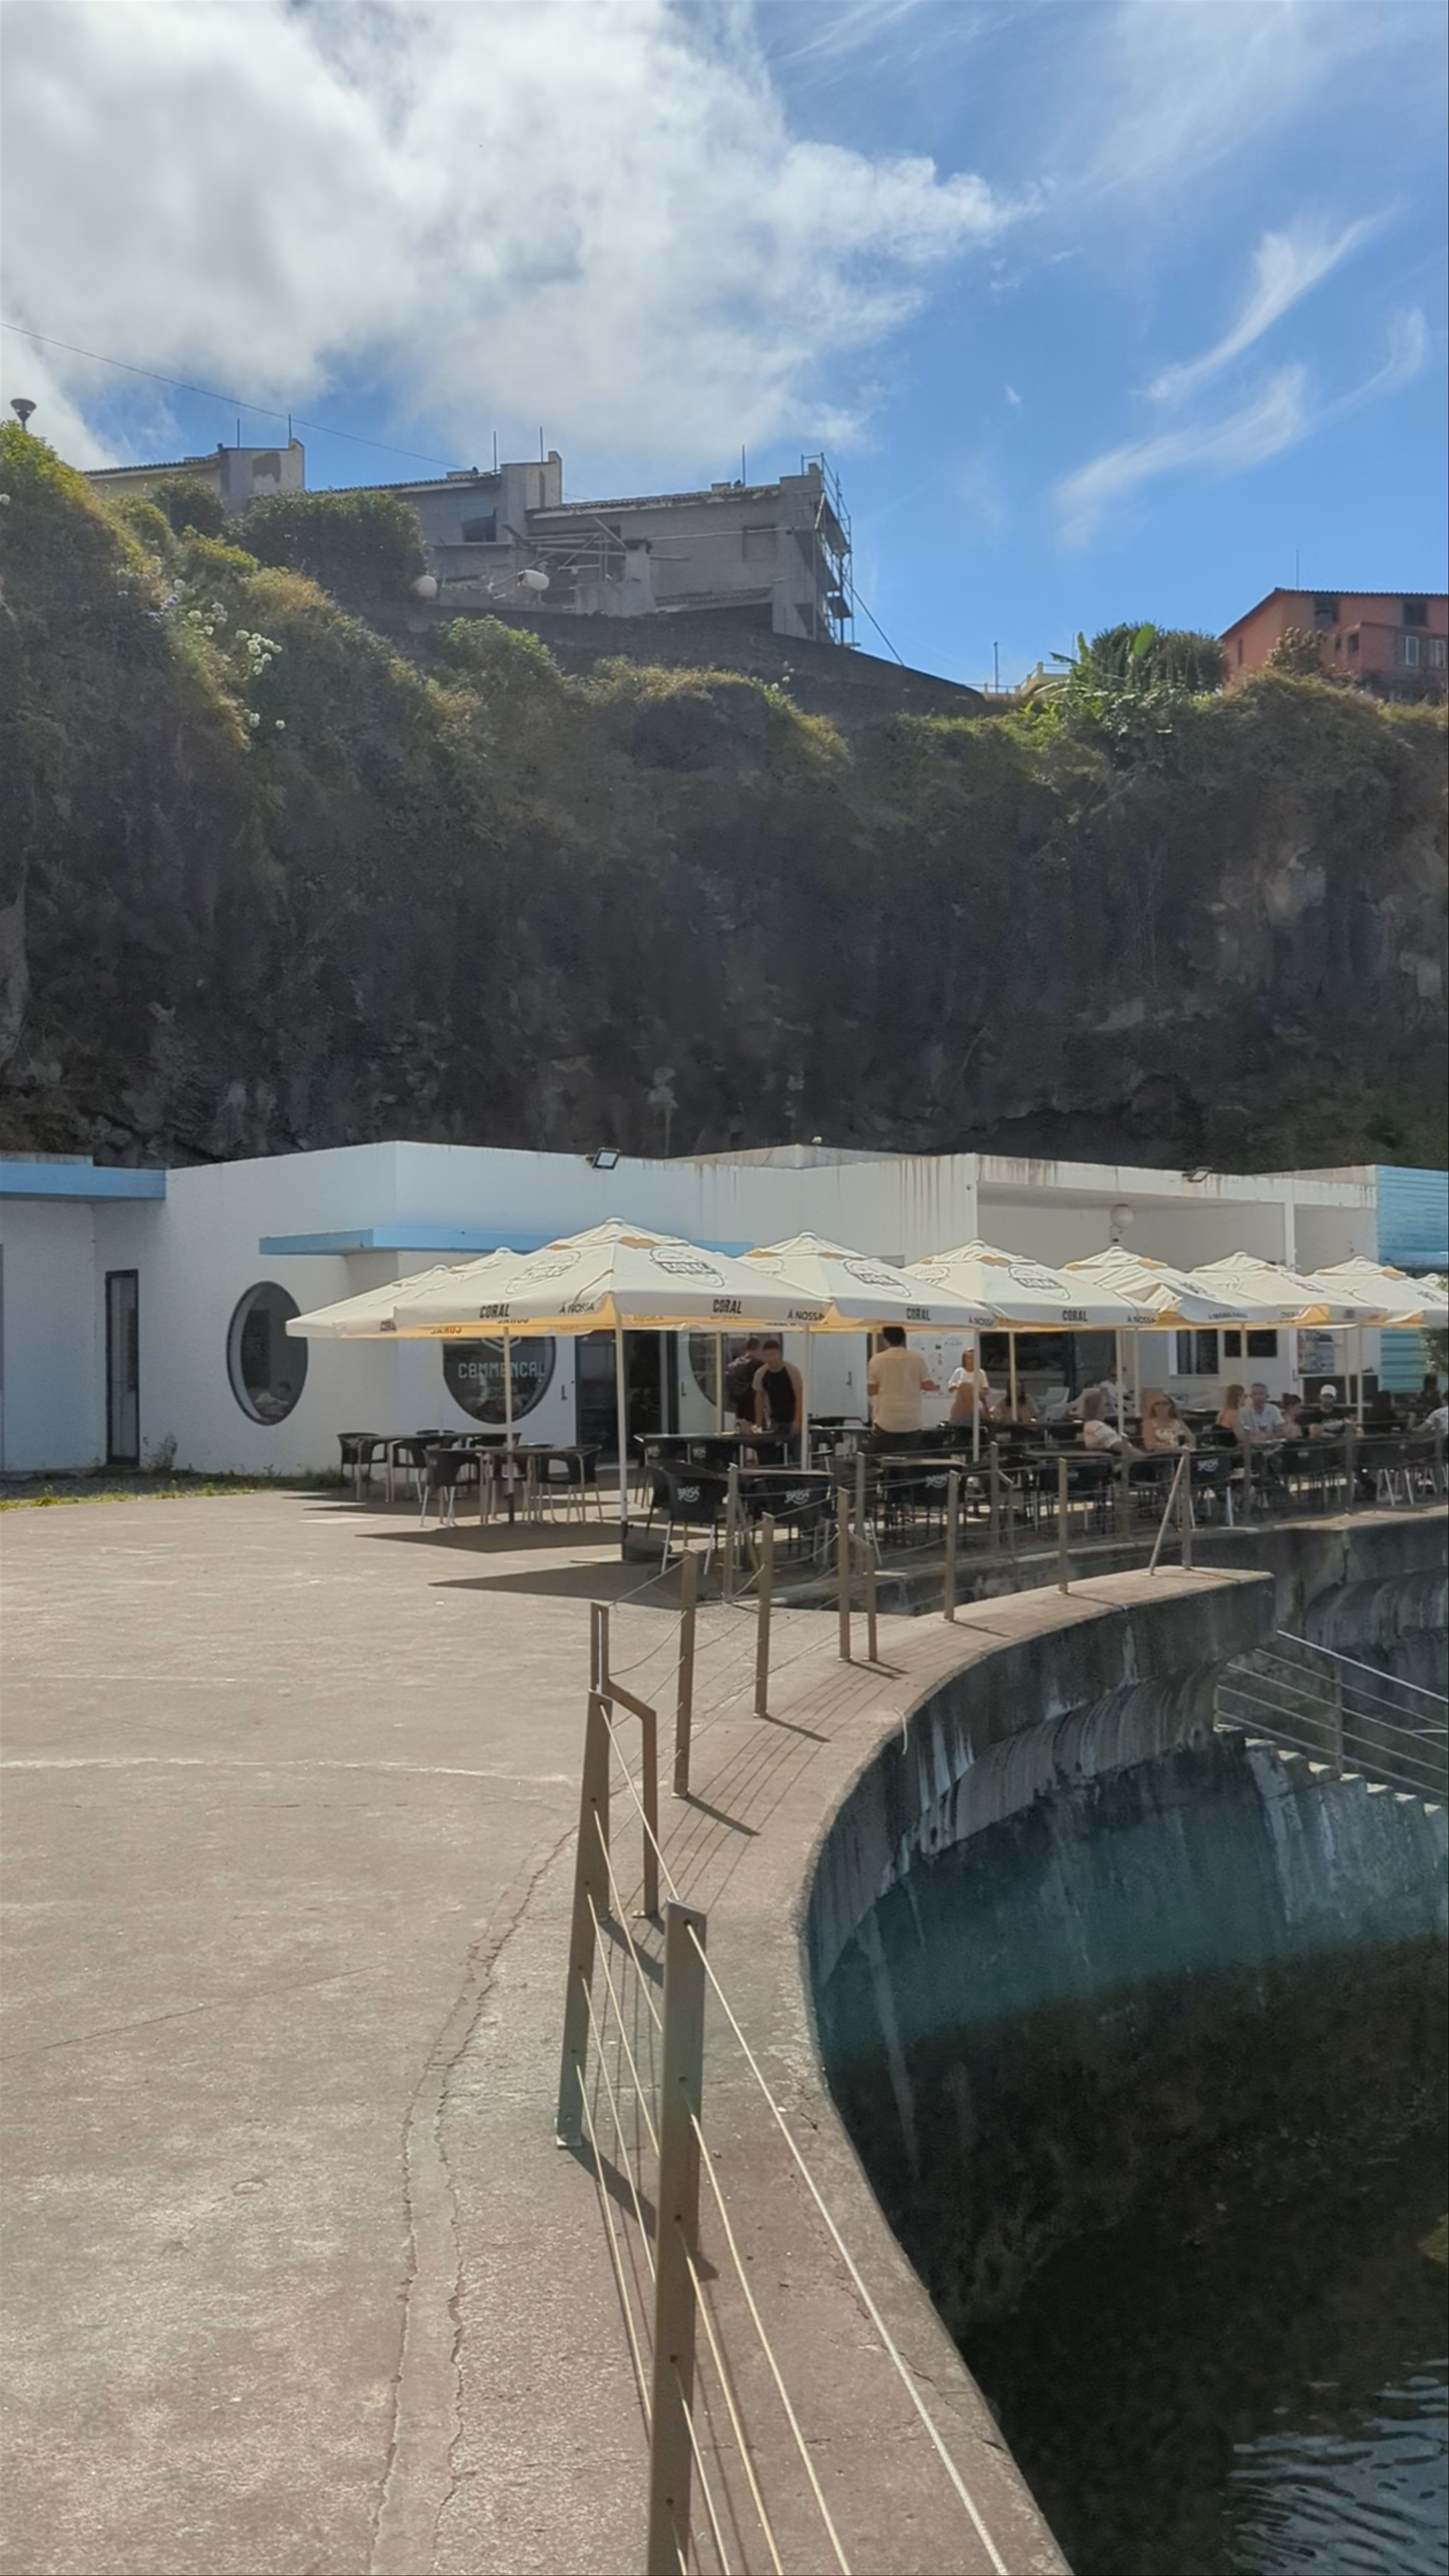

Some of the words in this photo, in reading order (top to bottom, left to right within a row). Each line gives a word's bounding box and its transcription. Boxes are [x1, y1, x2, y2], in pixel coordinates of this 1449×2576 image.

[480, 1304, 509, 1318] CORAL
[713, 1299, 742, 1314] CORAL
[1062, 1310, 1088, 1321] CORAL
